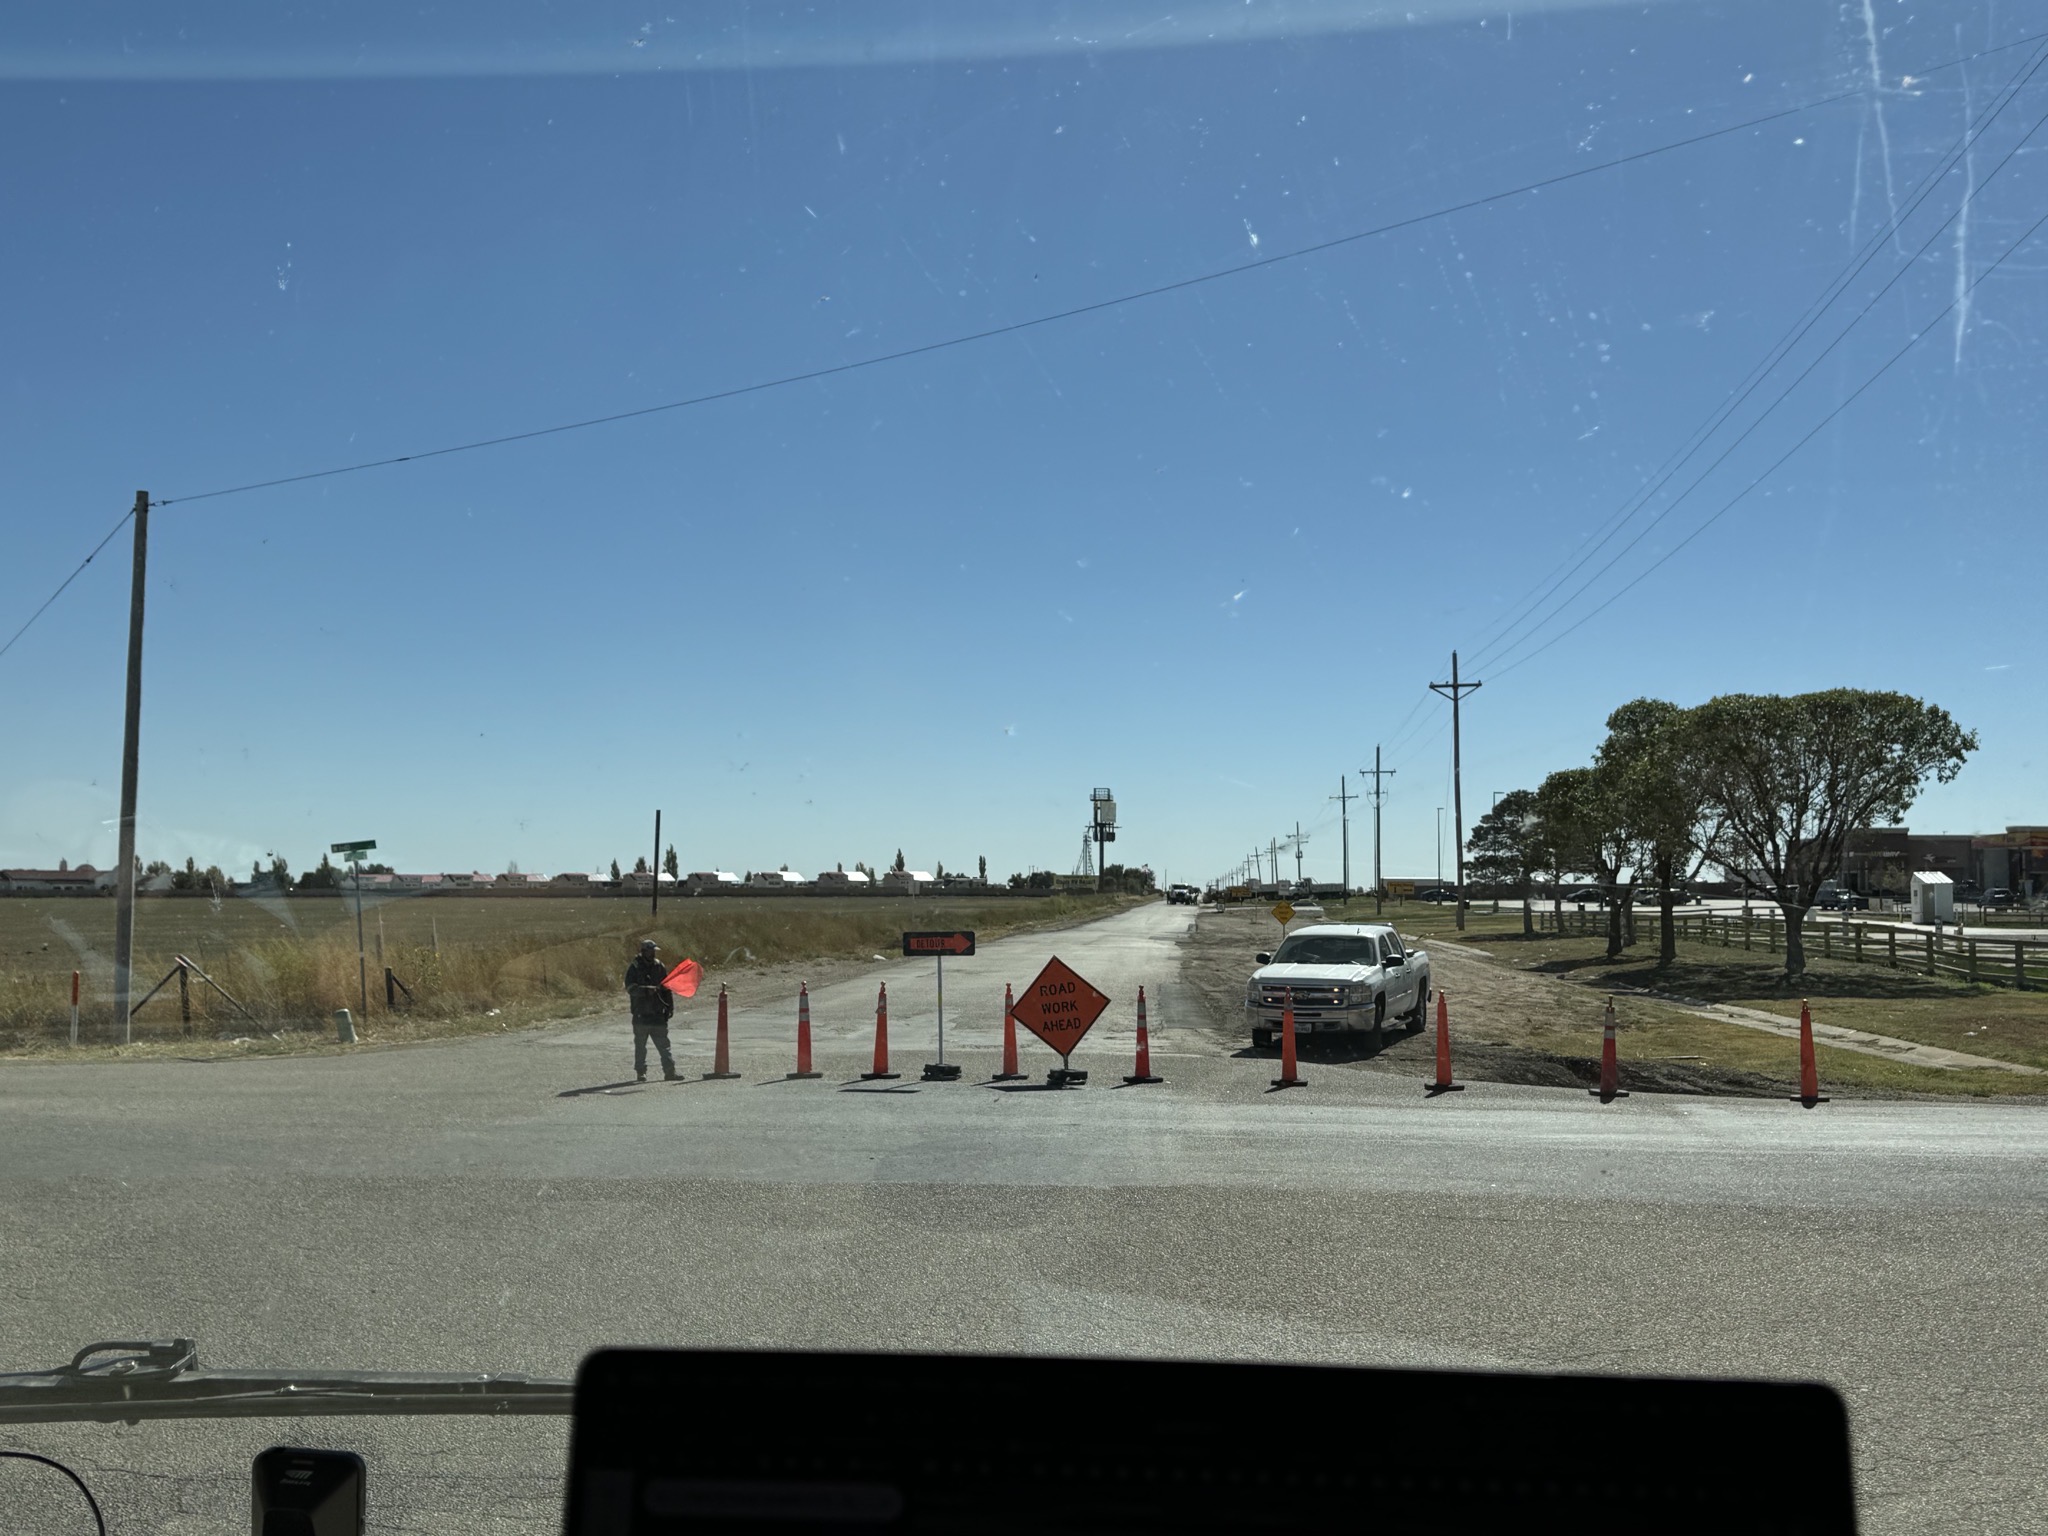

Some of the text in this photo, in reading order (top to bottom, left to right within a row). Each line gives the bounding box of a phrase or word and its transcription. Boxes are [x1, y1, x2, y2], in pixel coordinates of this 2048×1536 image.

[916, 938, 945, 949] DETOUR
[1039, 981, 1076, 997] ROAD
[1041, 1000, 1079, 1015] WORK
[1042, 1017, 1081, 1032] AHEAD
